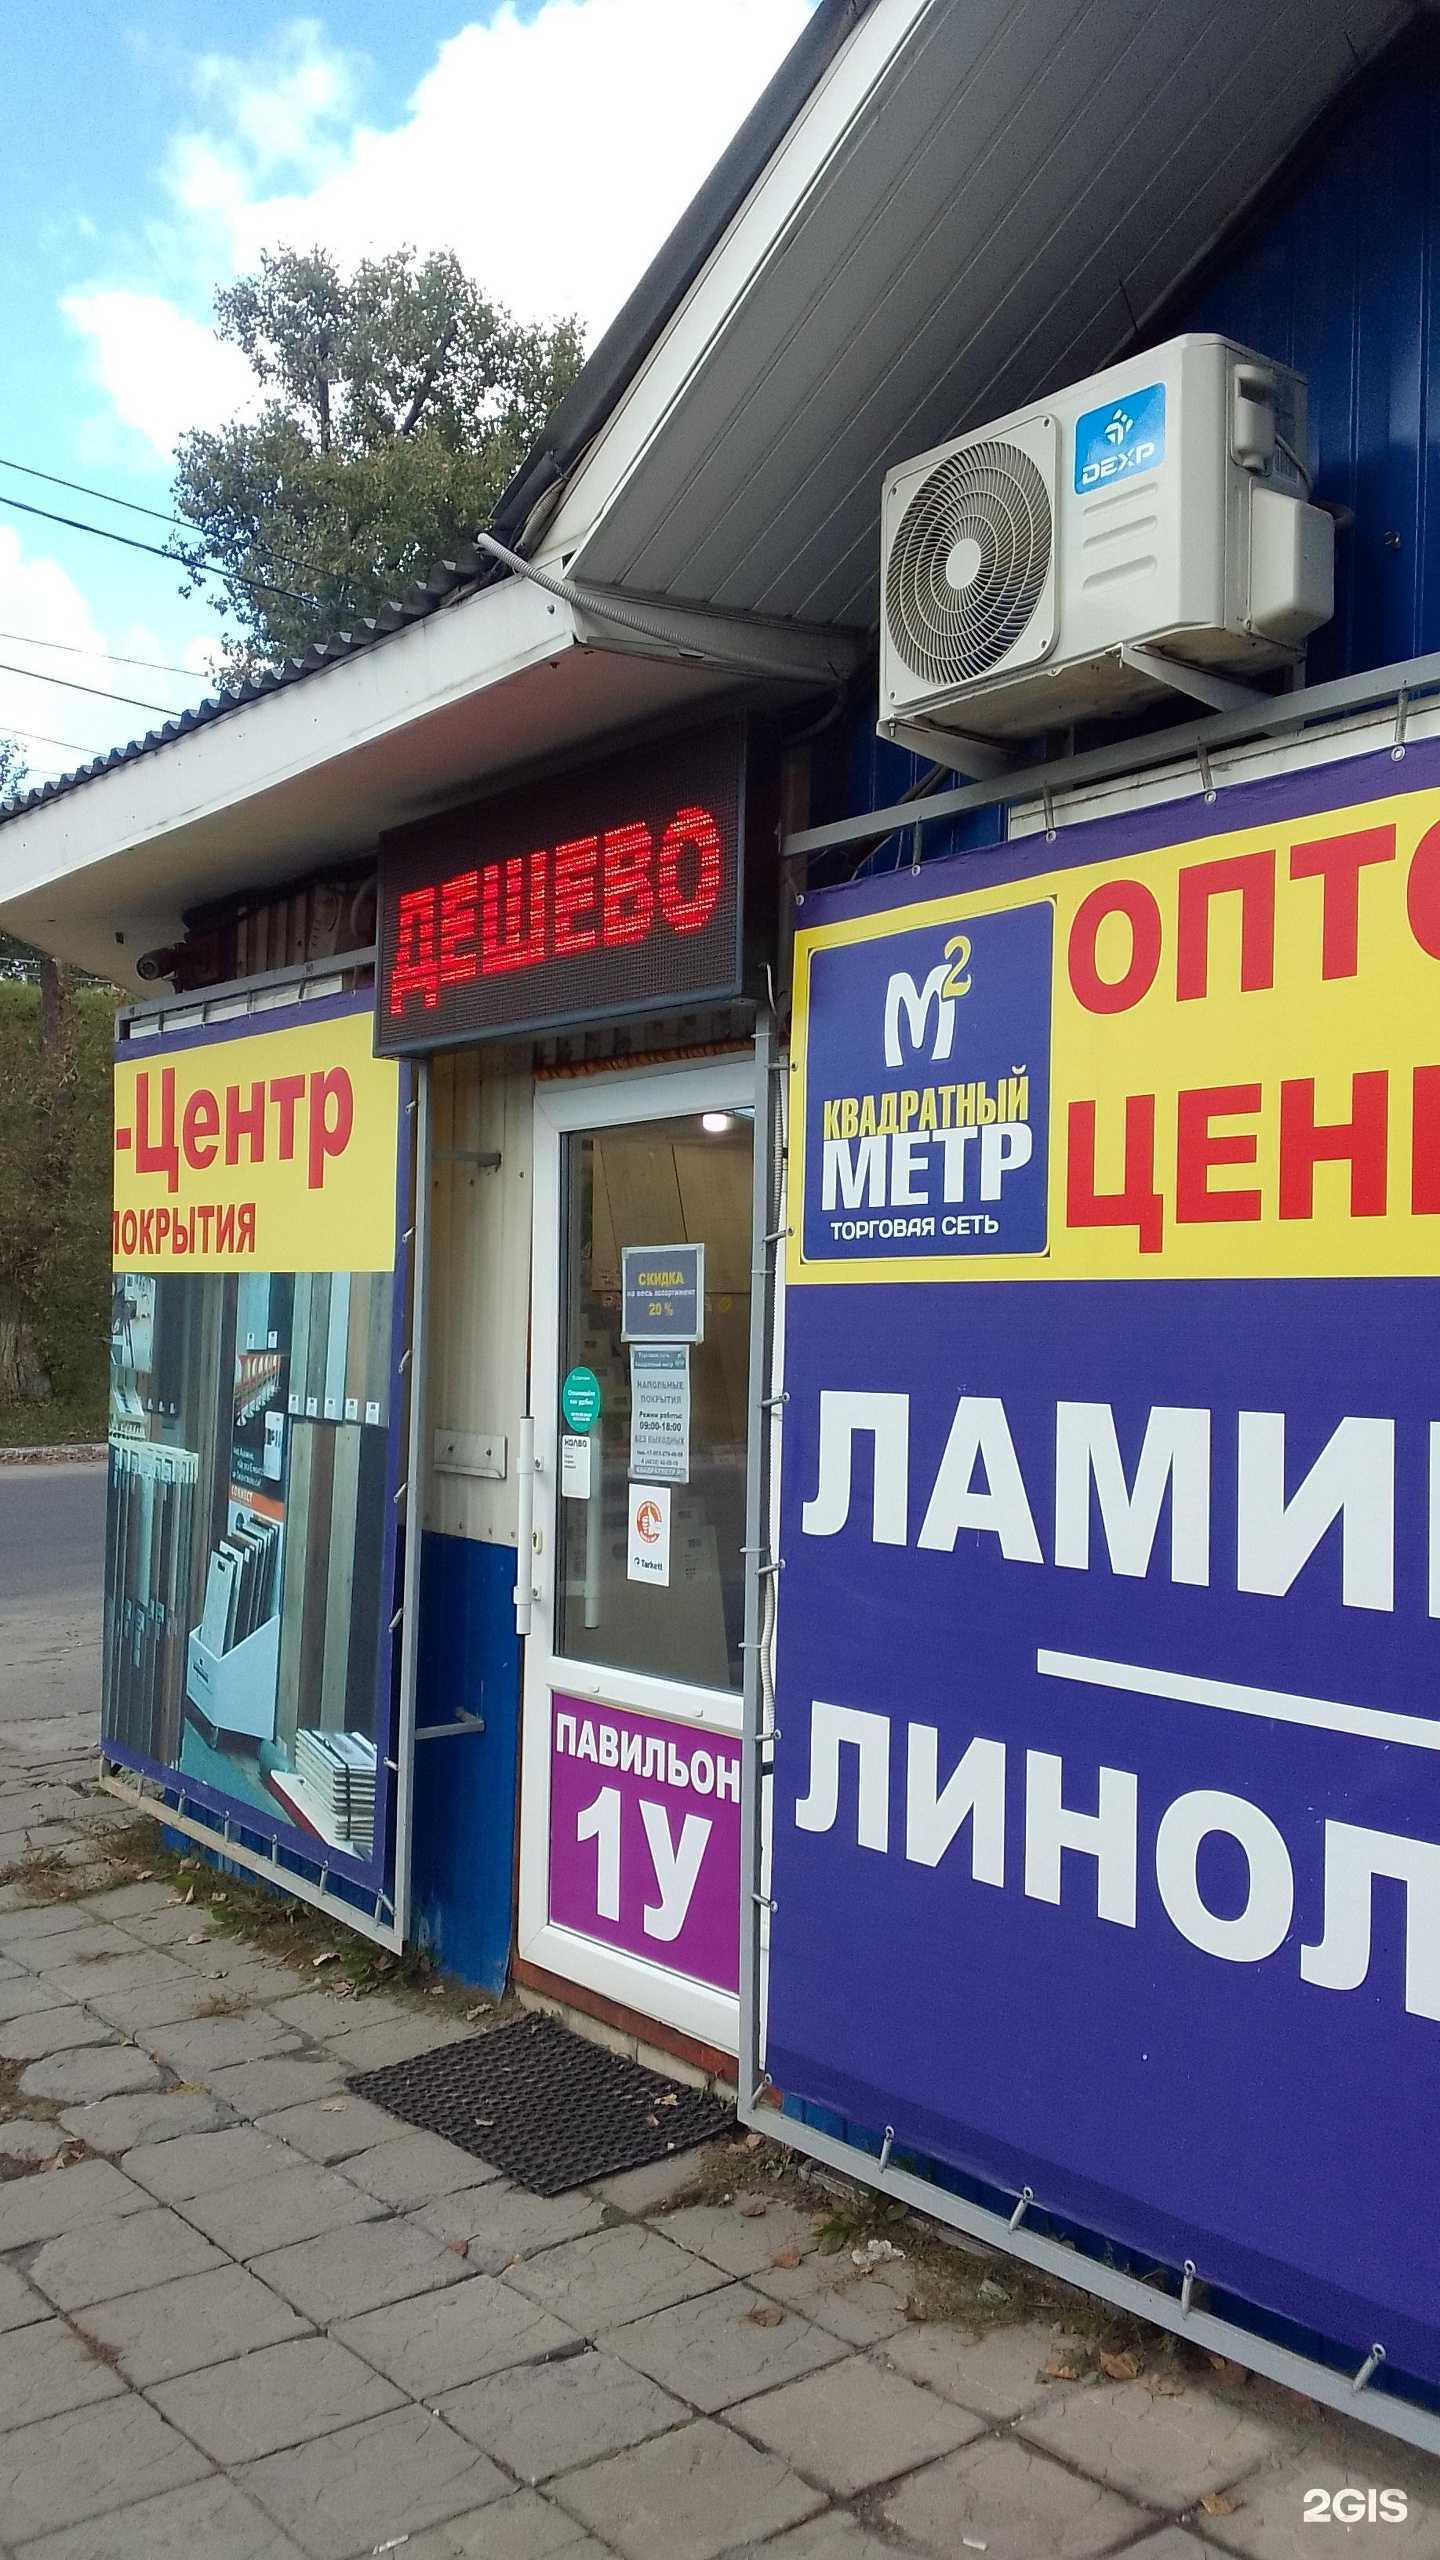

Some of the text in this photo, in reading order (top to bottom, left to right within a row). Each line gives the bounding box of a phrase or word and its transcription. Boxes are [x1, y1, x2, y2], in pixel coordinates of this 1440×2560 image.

[1082, 442, 1155, 485] DEXP
[390, 806, 722, 1017] ДЕШЕВО
[823, 1065, 1029, 1141] КВАДРАТНЫЙ
[822, 1122, 1033, 1212] МЕТР
[1066, 1065, 1440, 1254] ЦЕН
[830, 1215, 999, 1241] ТОРГОВАЯ СЕТЬ
[638, 1271, 684, 1287] СКИДКА
[648, 1302, 662, 1316] 20
[640, 1421, 682, 1432] 09:00-18:00
[802, 1390, 1440, 1618] ЛАМИ
[641, 1558, 663, 1571] Tarkett
[556, 1712, 740, 1804] ПАВИЛЬОН
[577, 1786, 713, 1941] 1У
